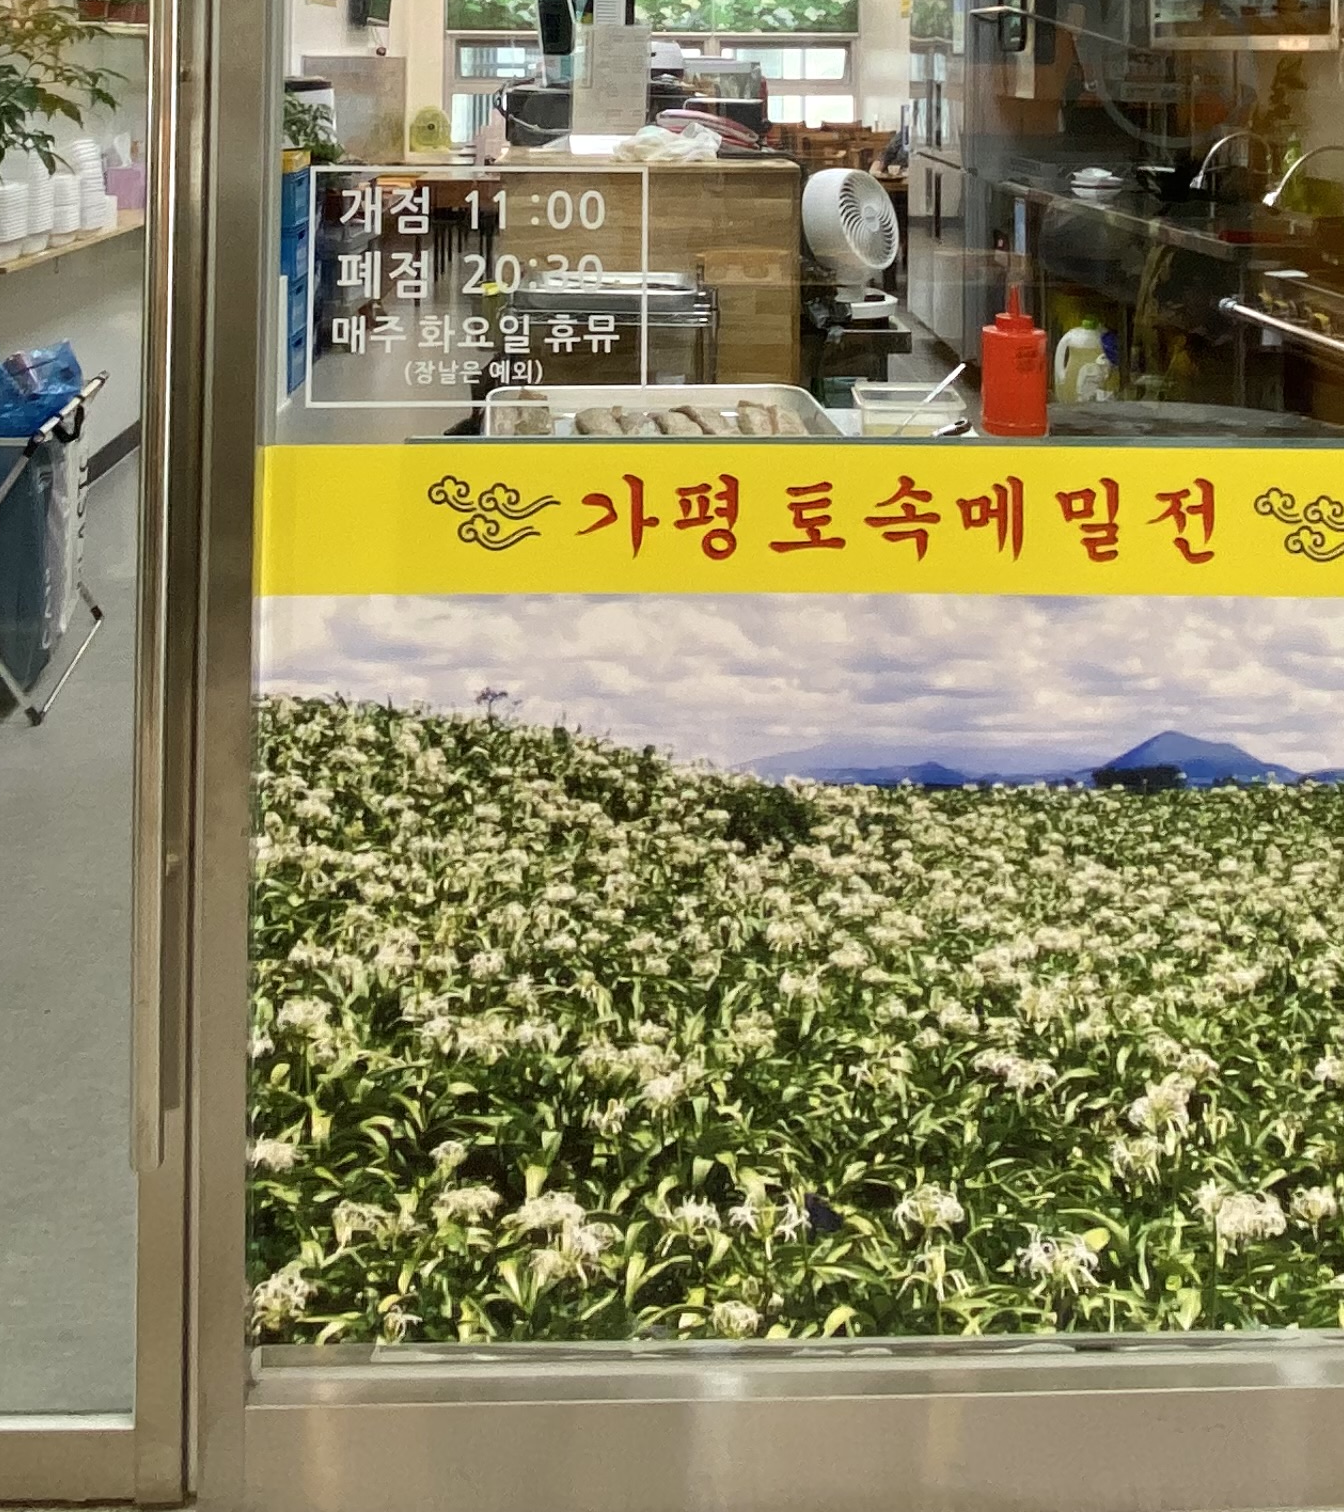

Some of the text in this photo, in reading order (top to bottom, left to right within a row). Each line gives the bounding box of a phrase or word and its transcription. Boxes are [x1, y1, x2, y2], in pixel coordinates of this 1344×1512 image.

[340, 186, 431, 236] 개점
[337, 250, 429, 300] 폐점
[331, 314, 406, 355] 매주
[418, 314, 532, 355] 화요일
[404, 359, 545, 385] (장날은 예외)
